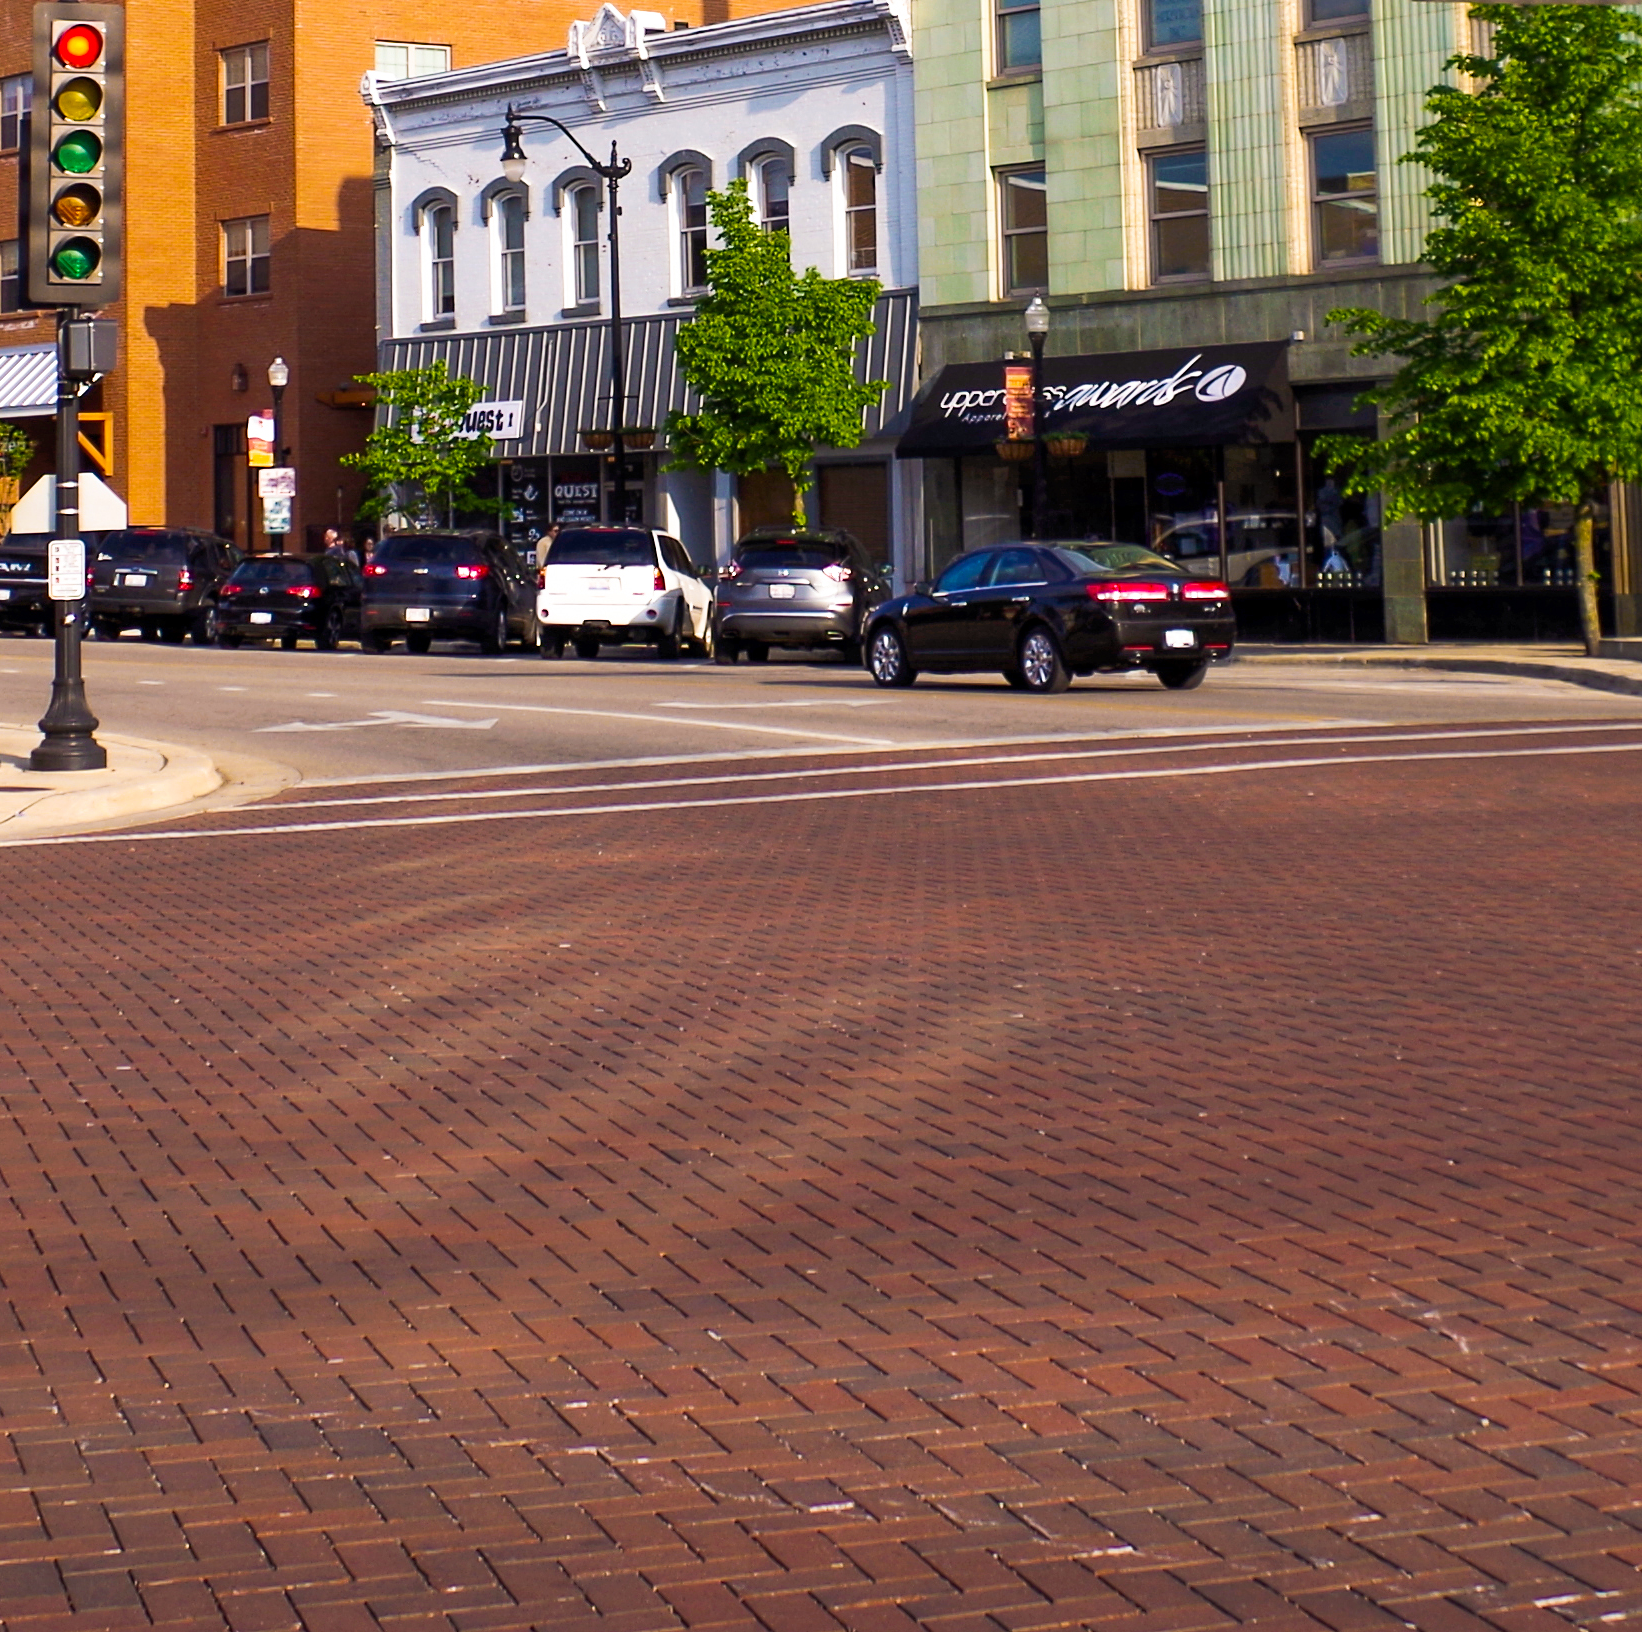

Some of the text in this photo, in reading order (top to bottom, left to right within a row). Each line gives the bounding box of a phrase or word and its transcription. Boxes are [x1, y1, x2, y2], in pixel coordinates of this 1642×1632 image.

[1053, 353, 1203, 412] awards
[458, 409, 504, 433] uest
[554, 484, 598, 498] QUEST
